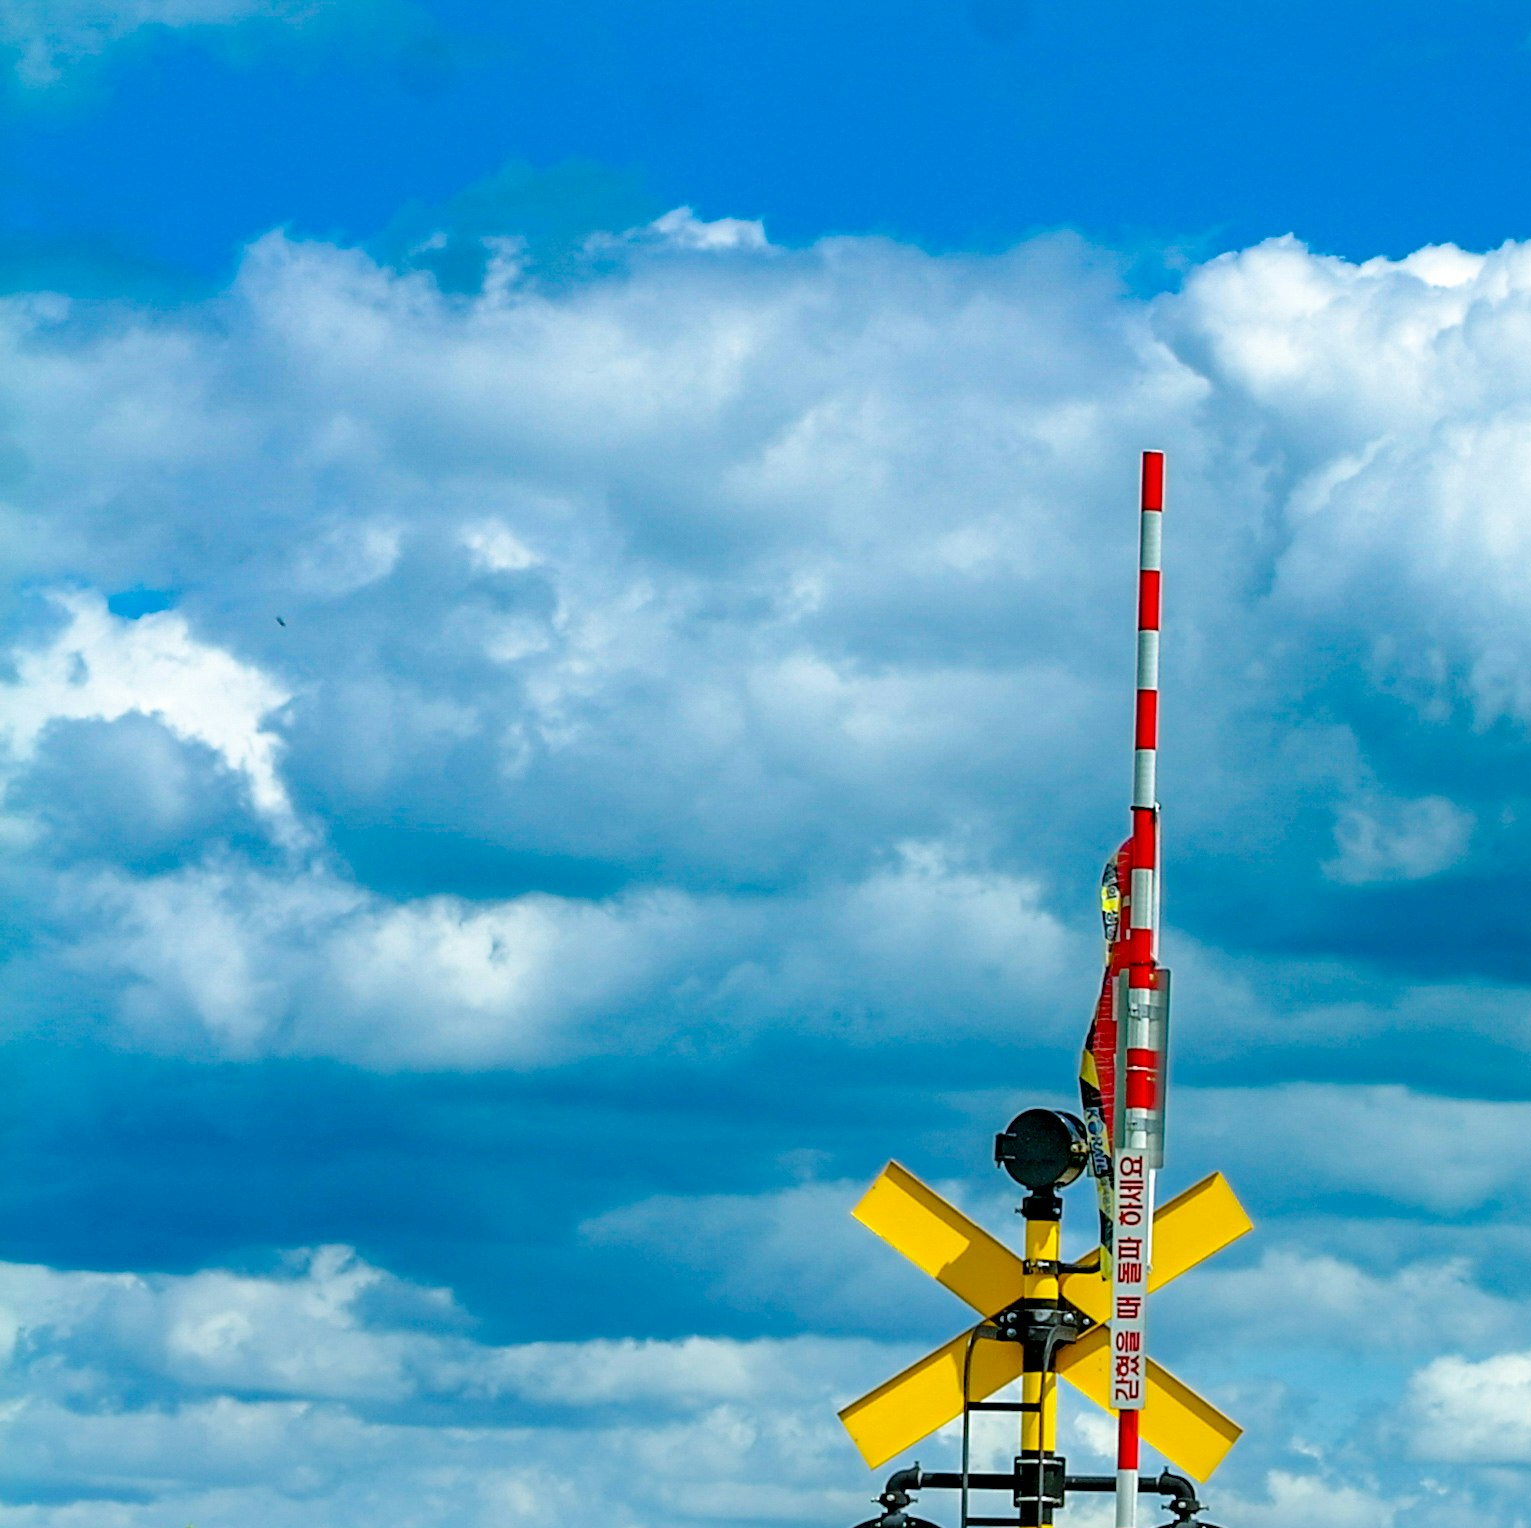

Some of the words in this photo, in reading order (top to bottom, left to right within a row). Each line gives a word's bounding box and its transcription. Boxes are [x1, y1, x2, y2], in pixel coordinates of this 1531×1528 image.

[1086, 1107, 1108, 1175] KORAIL
[1118, 1155, 1144, 1226] 하세요
[1117, 1237, 1143, 1284] 돌파
[1117, 1296, 1142, 1319] 때
[1115, 1331, 1142, 1401] 갇혔을
